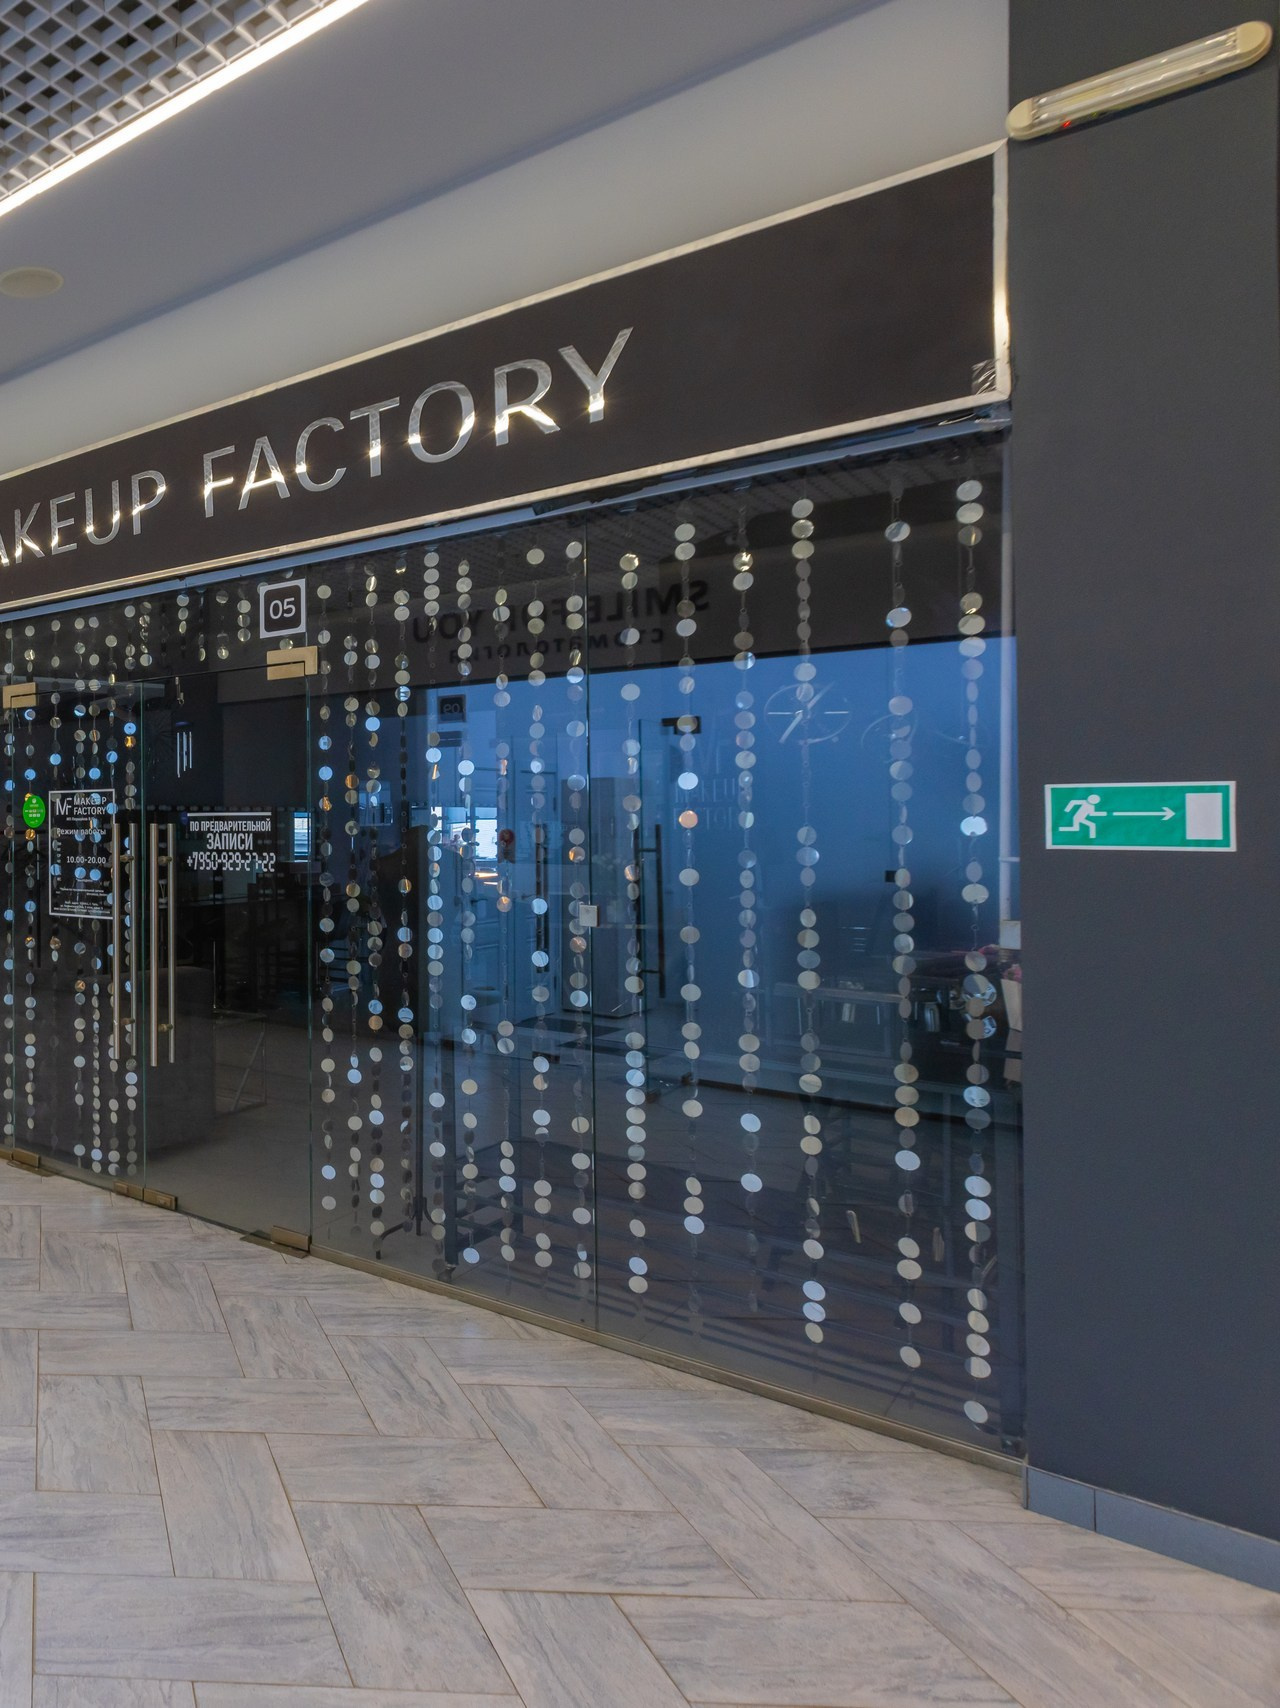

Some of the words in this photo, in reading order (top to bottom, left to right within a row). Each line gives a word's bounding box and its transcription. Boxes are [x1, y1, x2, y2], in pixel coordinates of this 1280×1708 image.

[203, 326, 635, 518] FACTORY
[269, 597, 296, 620] 05
[73, 806, 107, 815] FACTORY
[189, 821, 200, 832] ПО
[200, 818, 272, 832] ПРЕДВАРИТЕЛЬНОЙ
[206, 832, 254, 850] ЗАПИСИ
[66, 855, 107, 864] 10.00-20.00
